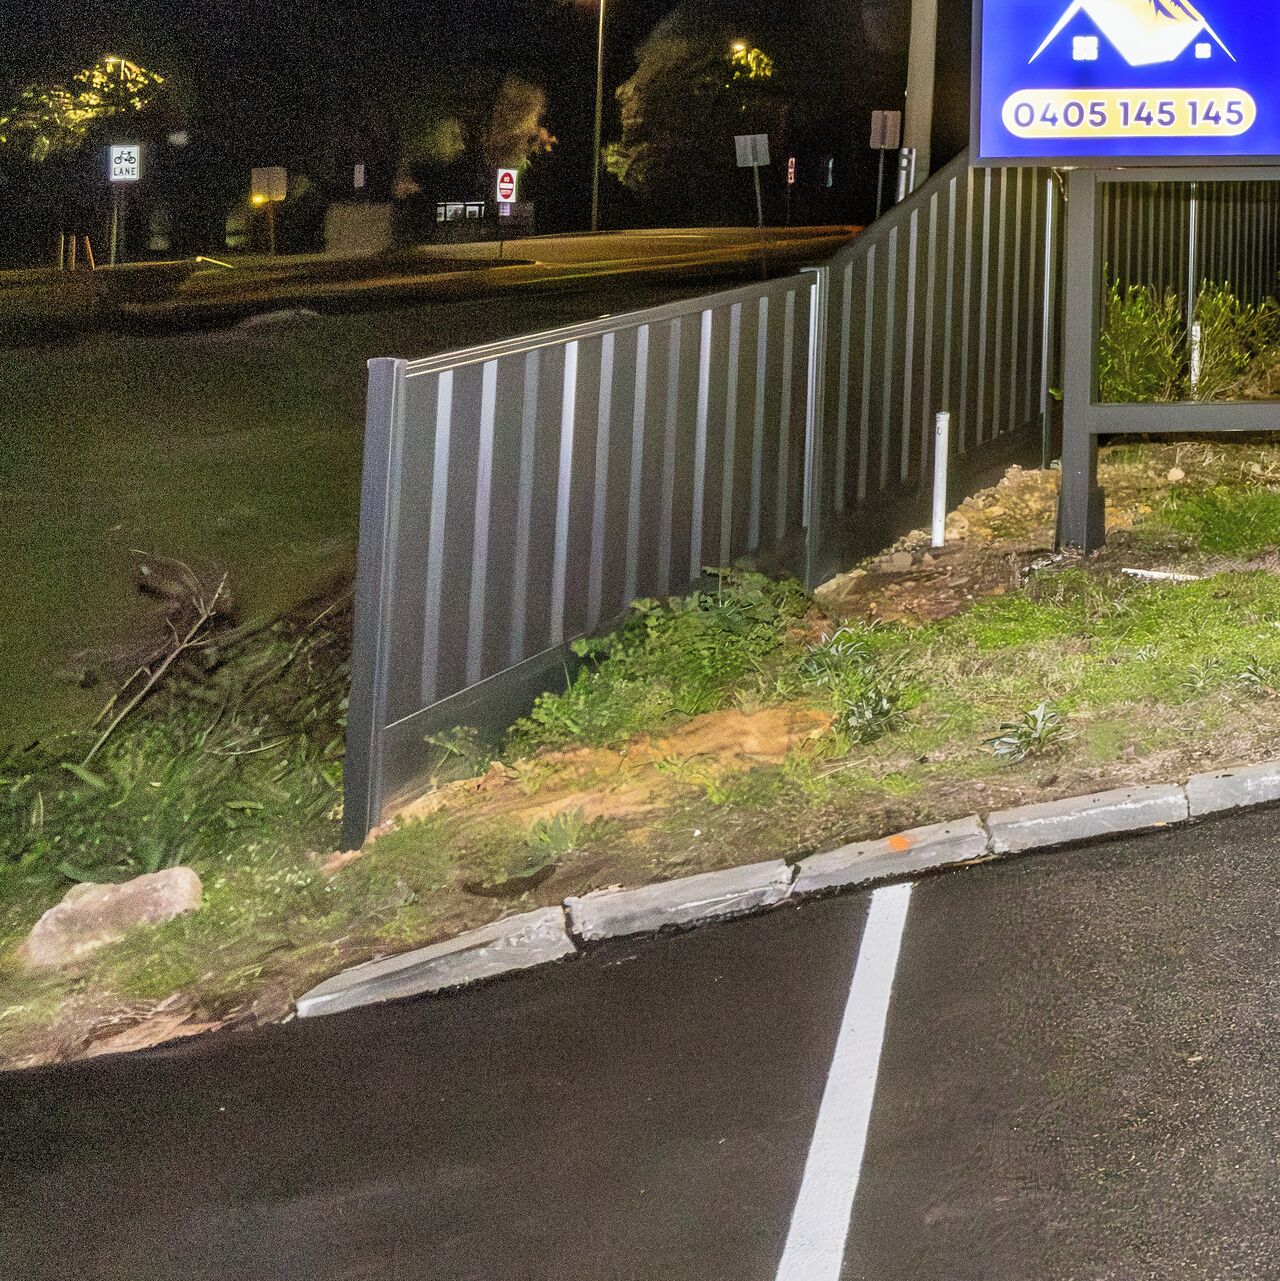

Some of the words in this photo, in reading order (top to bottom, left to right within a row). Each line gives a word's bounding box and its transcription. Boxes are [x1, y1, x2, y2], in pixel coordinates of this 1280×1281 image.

[1013, 101, 1108, 128] 0405
[1119, 101, 1176, 127] 145
[1187, 100, 1244, 126] 145
[113, 167, 136, 176] LANE
